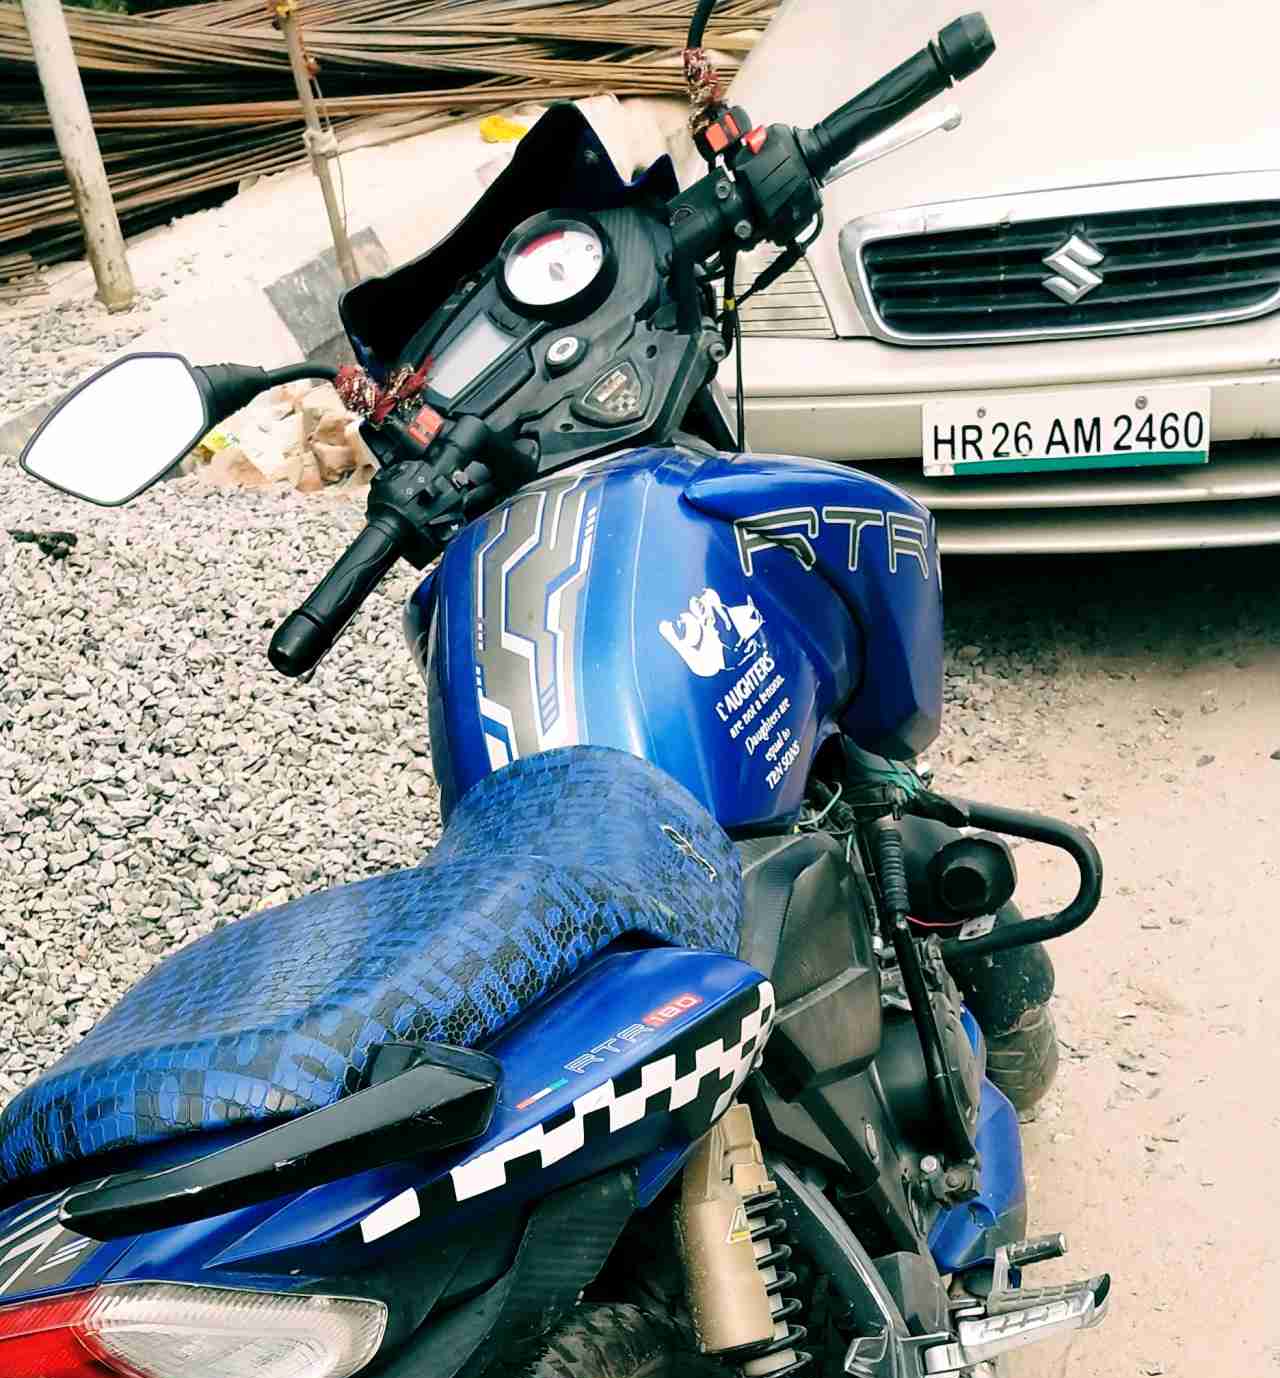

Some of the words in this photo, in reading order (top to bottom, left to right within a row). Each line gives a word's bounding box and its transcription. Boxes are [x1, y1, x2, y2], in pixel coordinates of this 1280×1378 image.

[1045, 416, 1102, 455] AM
[1112, 411, 1204, 451] 2460
[733, 506, 930, 580] RTR
[729, 720, 745, 739] are
[741, 704, 758, 724] not
[745, 710, 782, 756] Daughters
[778, 697, 792, 715] are
[765, 732, 785, 762] equal
